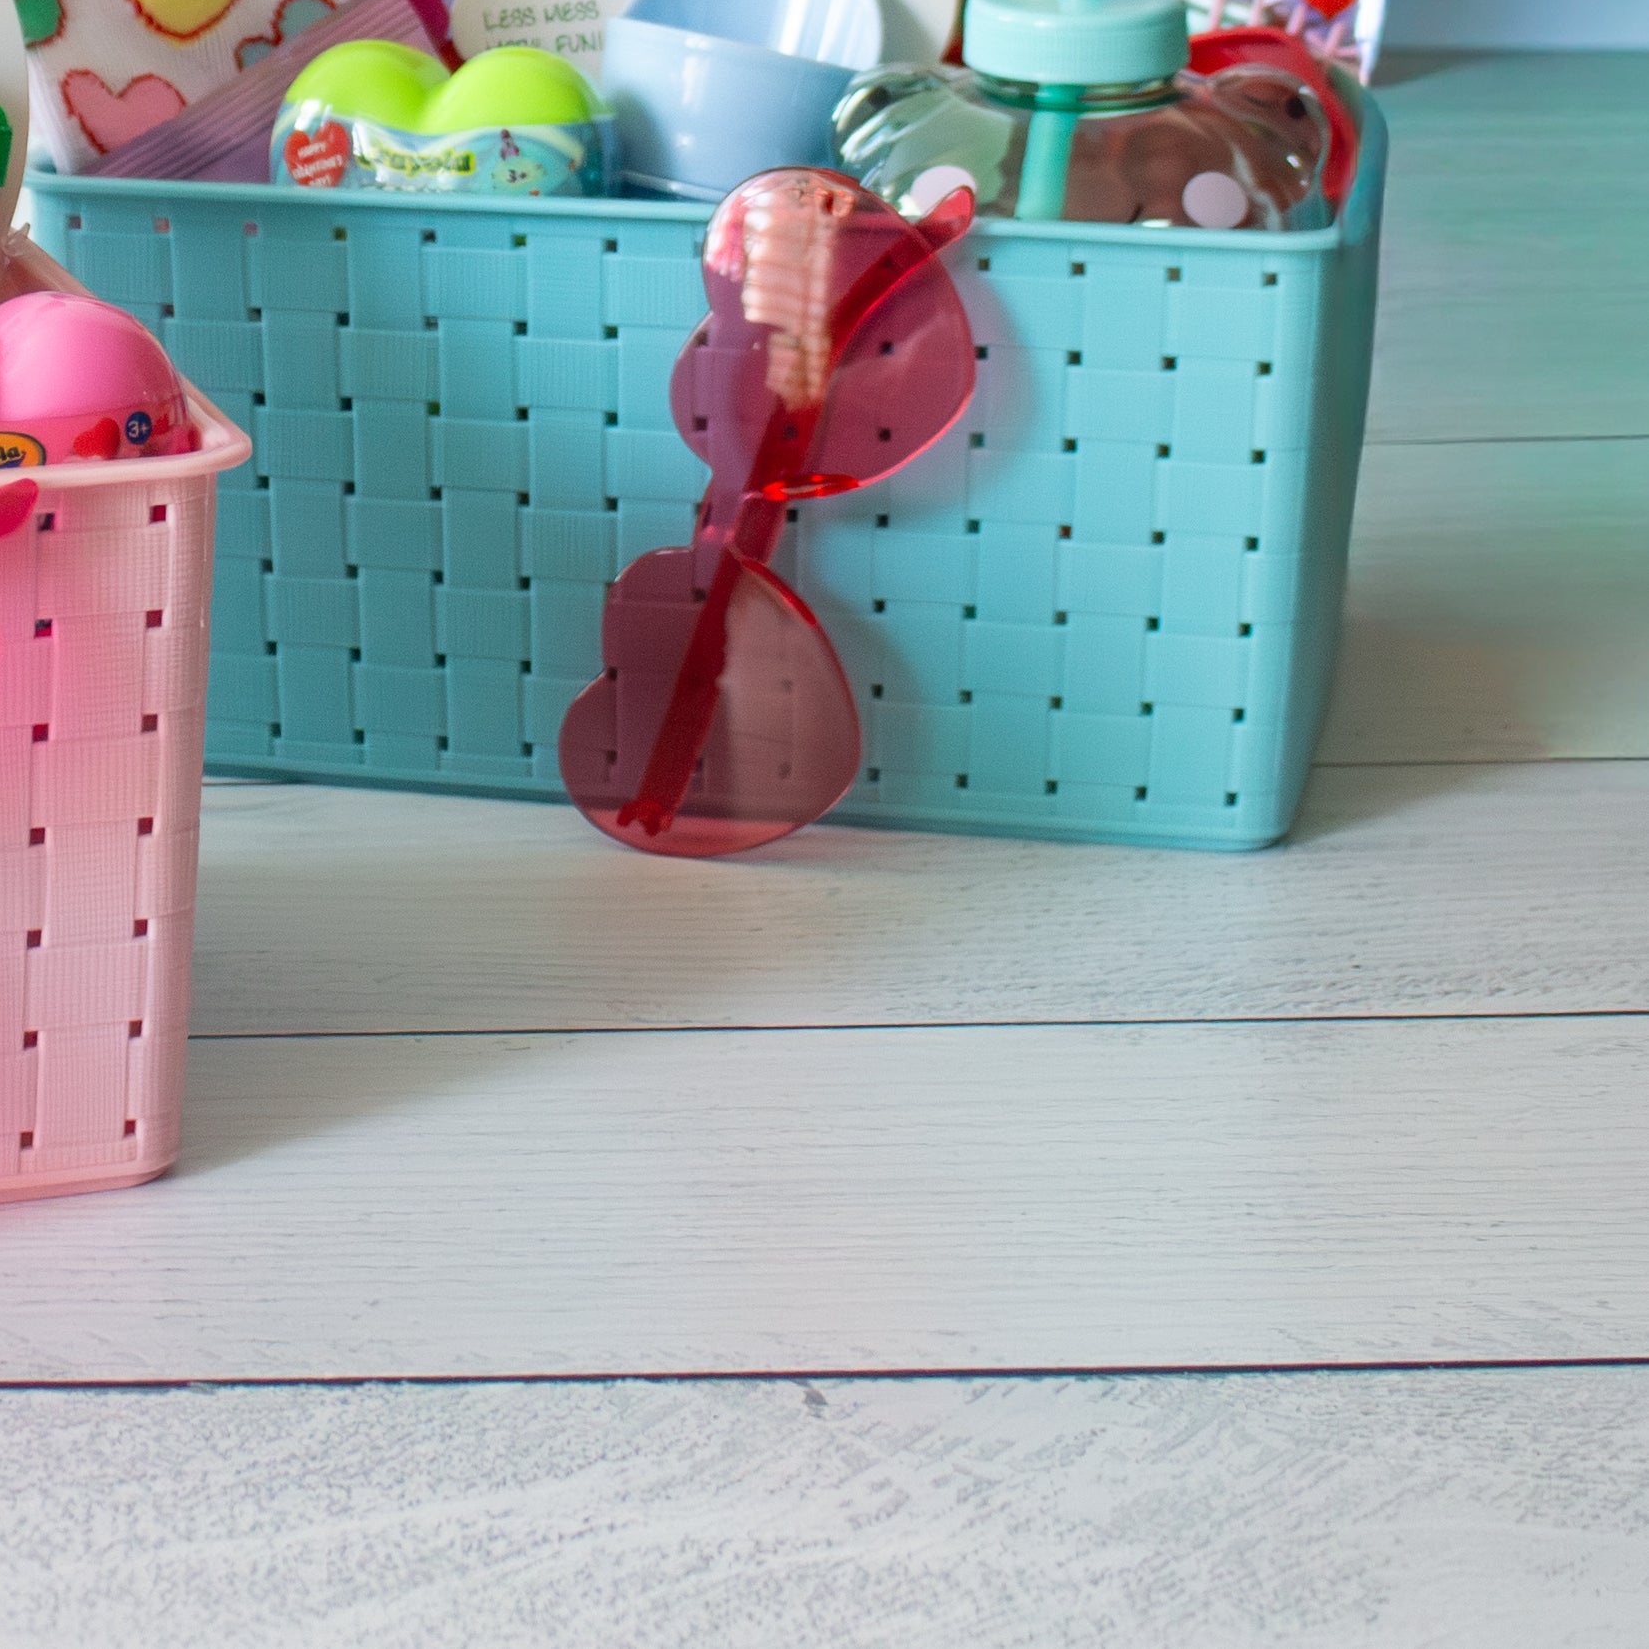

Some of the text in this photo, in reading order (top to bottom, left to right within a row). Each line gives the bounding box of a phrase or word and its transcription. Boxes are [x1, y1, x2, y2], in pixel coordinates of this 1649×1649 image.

[483, 0, 600, 31] LESS MESS
[128, 419, 150, 439] 3+
